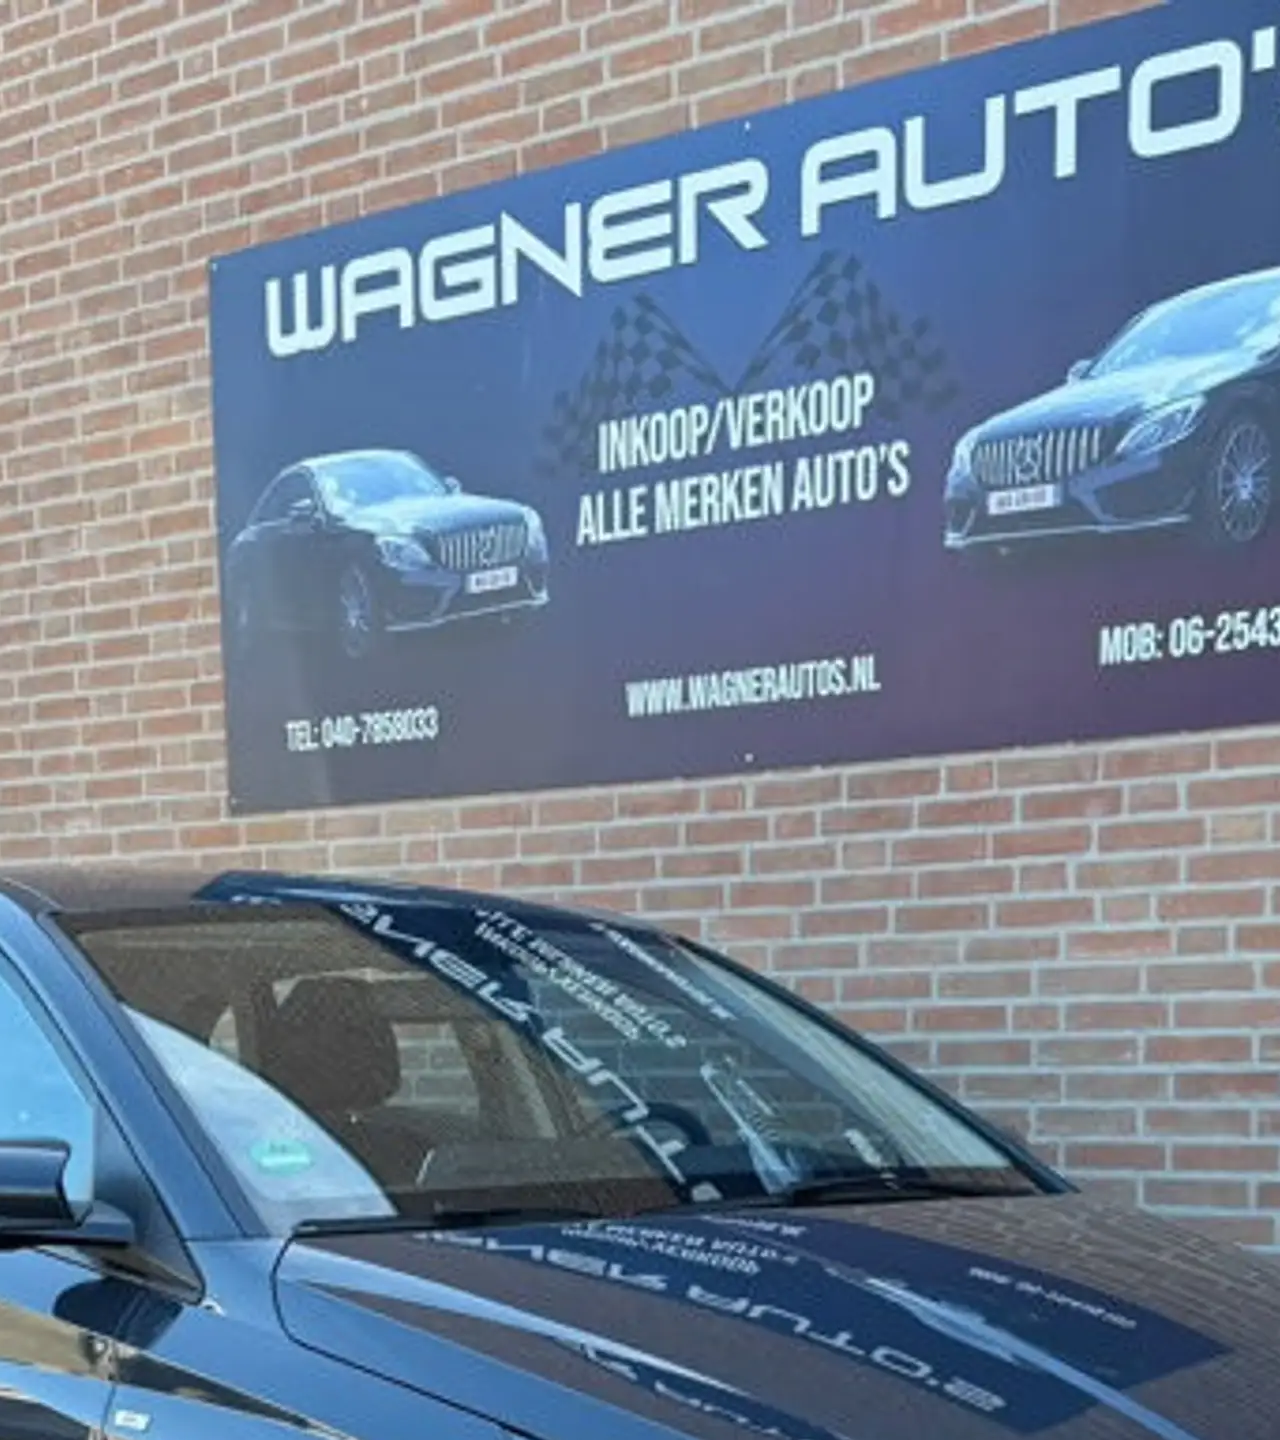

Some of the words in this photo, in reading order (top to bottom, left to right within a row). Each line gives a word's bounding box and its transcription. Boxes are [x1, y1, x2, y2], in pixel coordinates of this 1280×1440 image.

[265, 158, 769, 357] WAGNER
[598, 372, 875, 474] INKOOP/VERKOOP
[576, 485, 649, 546] ALLE
[654, 460, 784, 534] MERKEN
[790, 440, 910, 512] AUTO'S
[1099, 621, 1164, 666] MOB:
[625, 653, 881, 718] WWW.WAGNERAUTOS.NL
[284, 719, 320, 752] TEL:
